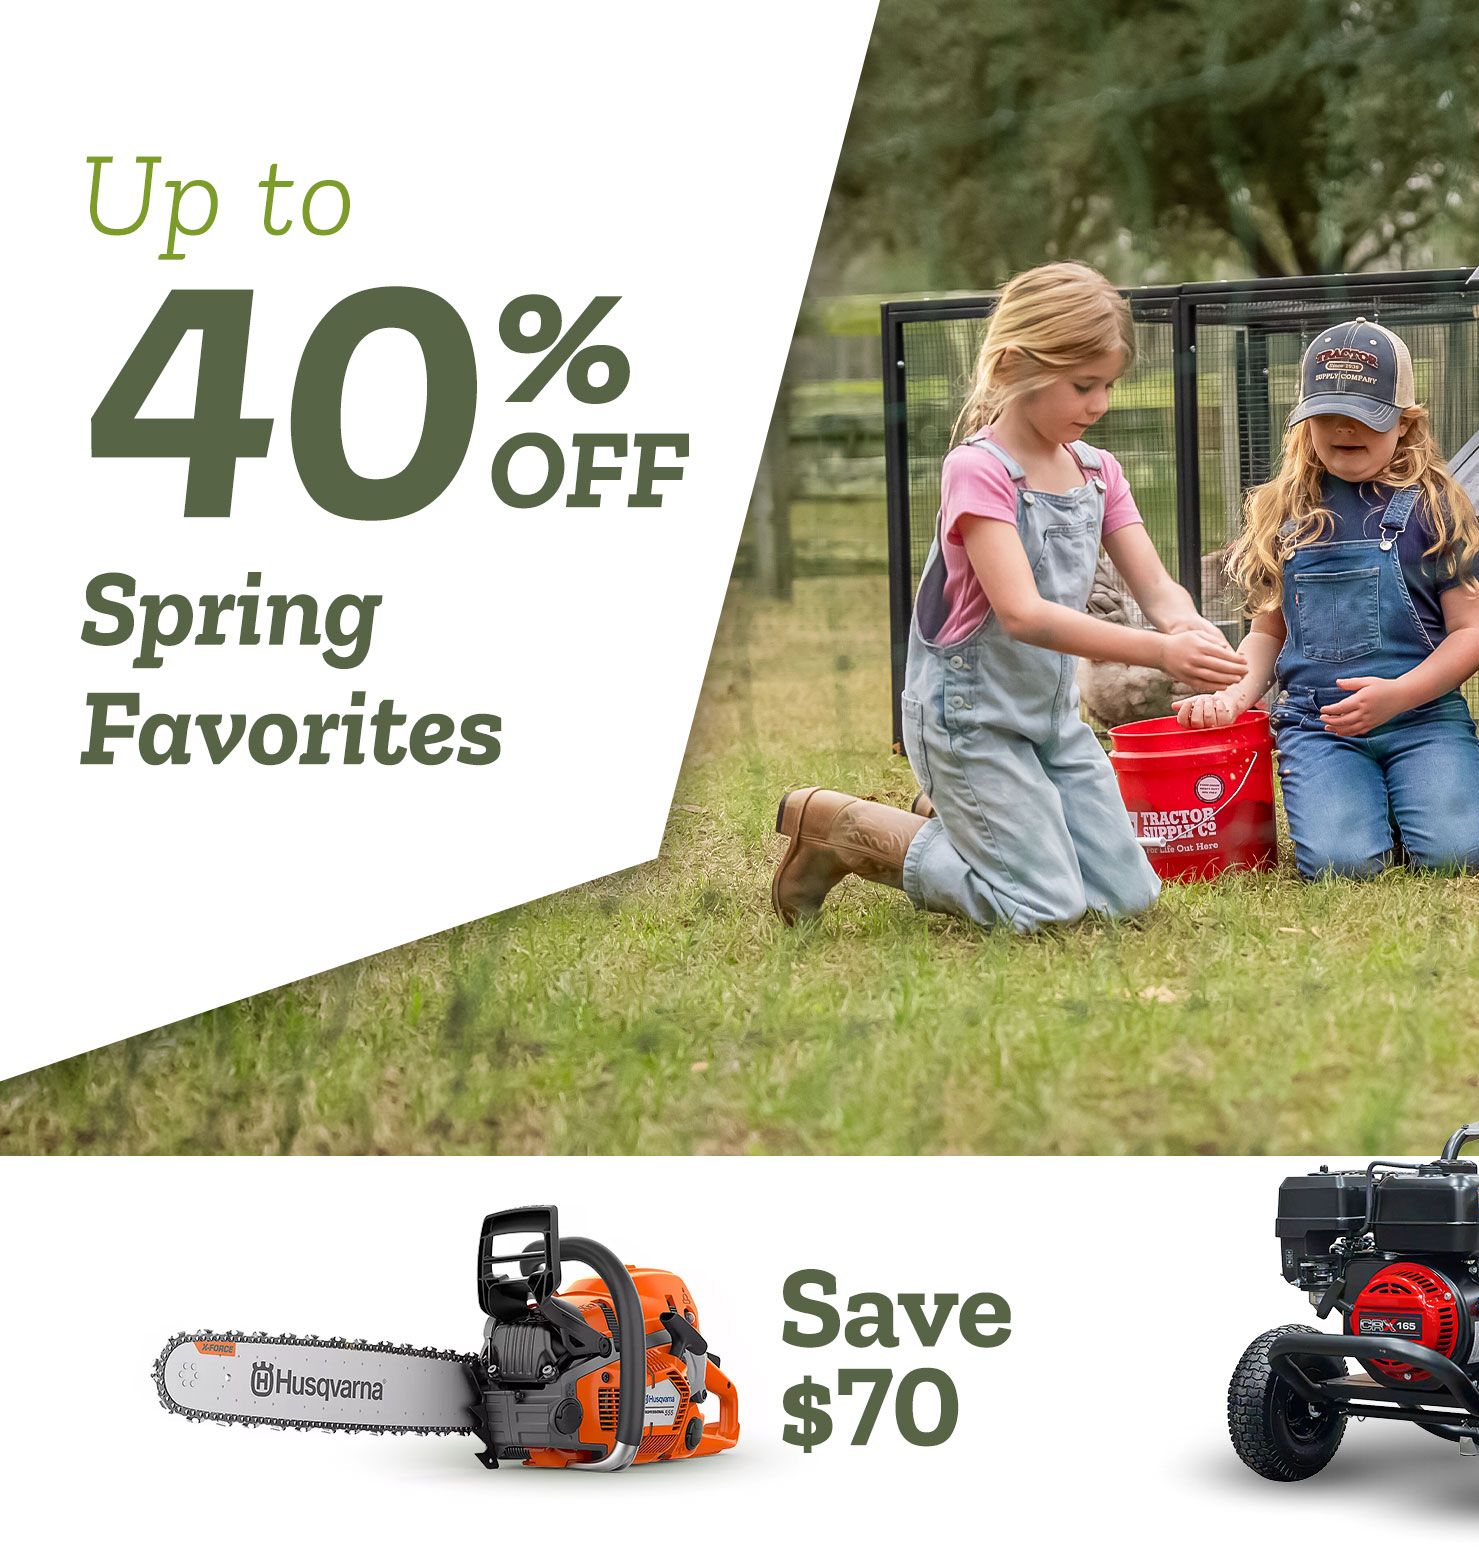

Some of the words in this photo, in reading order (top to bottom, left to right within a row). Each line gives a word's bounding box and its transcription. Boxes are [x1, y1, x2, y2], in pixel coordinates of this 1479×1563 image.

[1316, 348, 1378, 368] TRACTOR
[1315, 373, 1339, 381] SUPPLY
[1341, 373, 1377, 384] COMPANY
[1141, 807, 1215, 825] TRACTOR
[1143, 823, 1195, 839] SUPPLY
[1160, 845, 1175, 853] Life
[1176, 844, 1194, 852] Out
[1196, 842, 1219, 851] Here
[1360, 1318, 1397, 1332] CRX
[1397, 1321, 1416, 1331] 165
[201, 1343, 234, 1354] X-FORCE
[275, 1368, 384, 1402] Husqvarna
[648, 1395, 675, 1403] Husqvarna
